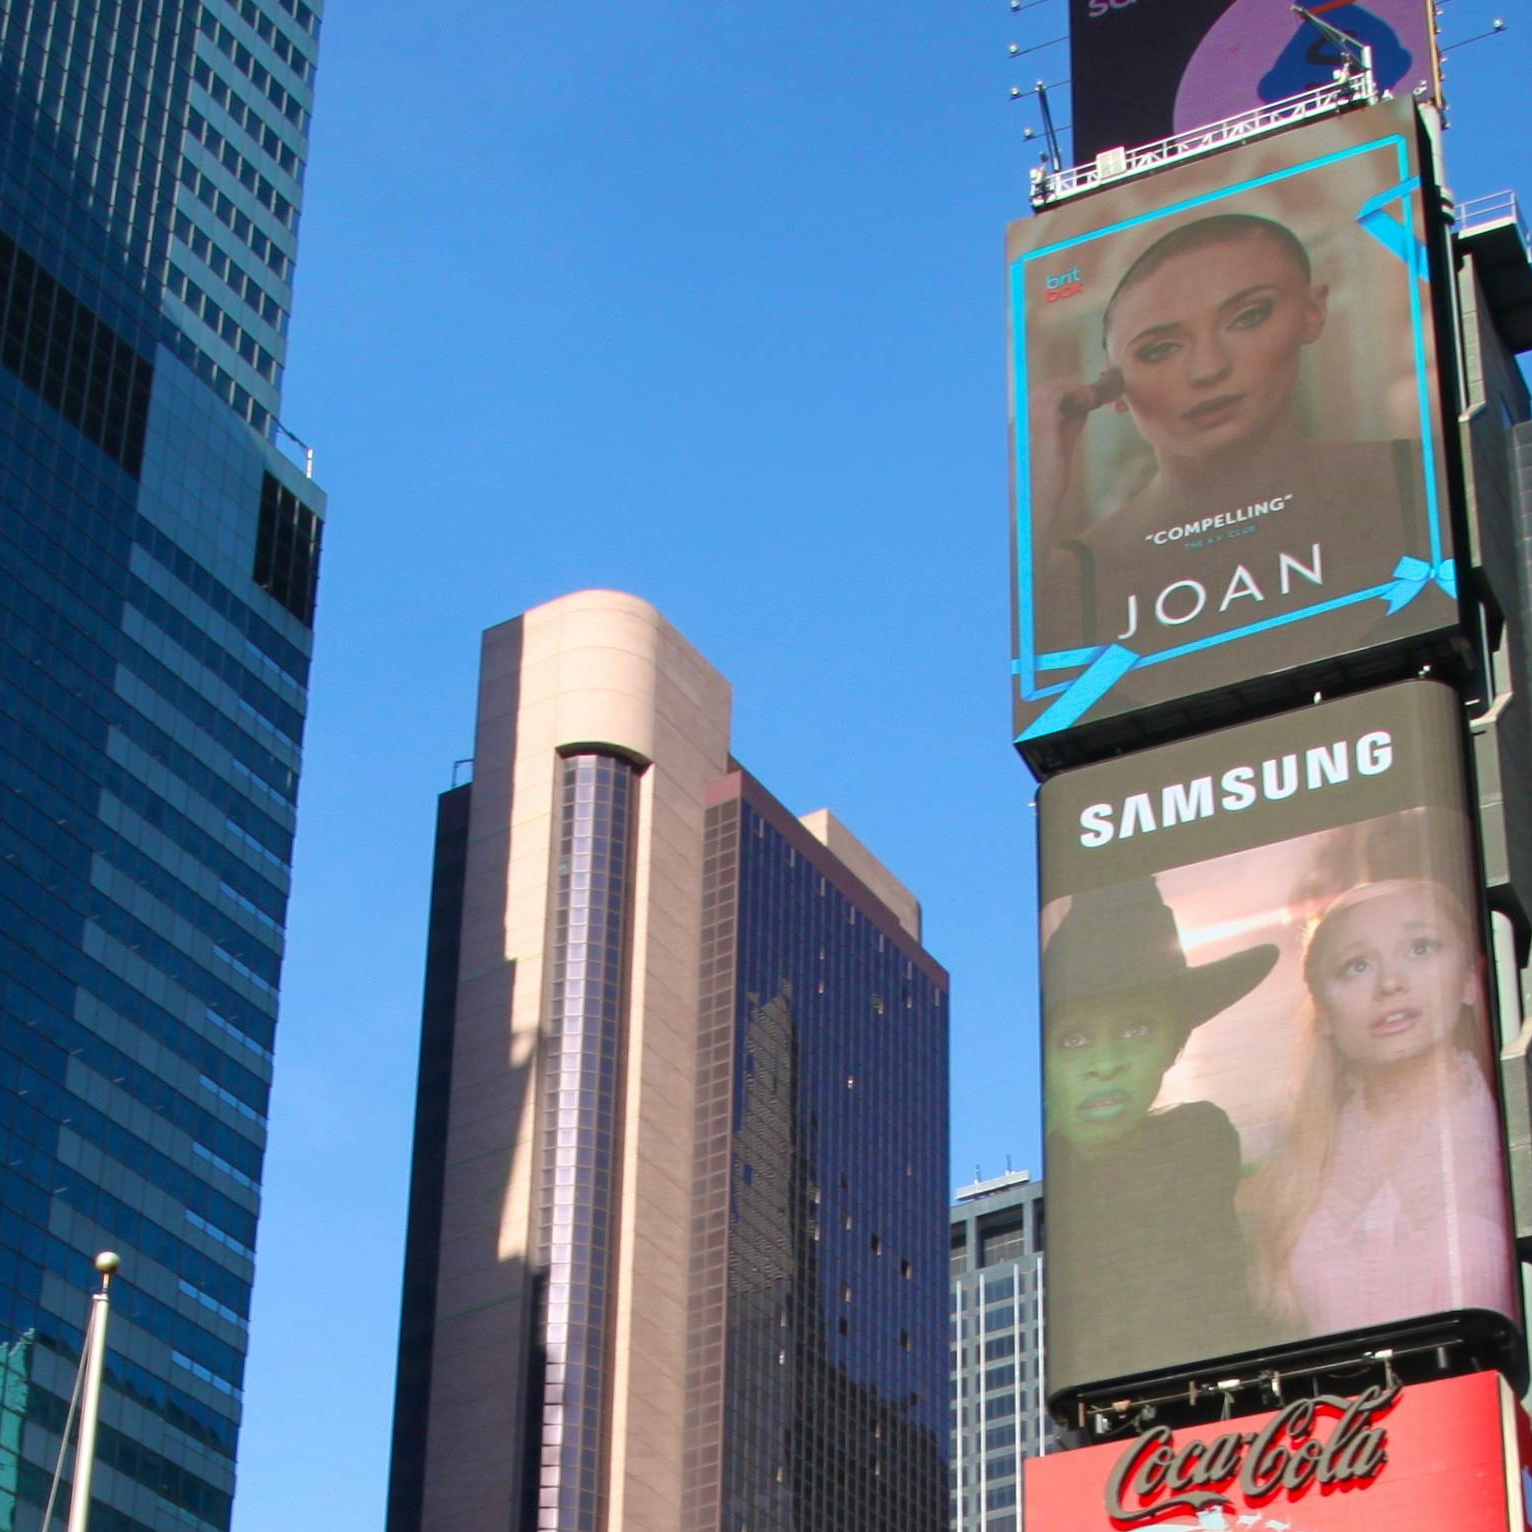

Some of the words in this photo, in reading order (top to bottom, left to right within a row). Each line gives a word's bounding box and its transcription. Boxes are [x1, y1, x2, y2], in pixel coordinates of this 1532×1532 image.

[1117, 542, 1323, 641] JOAN
[1079, 731, 1393, 848] SAMSUNG
[1104, 1380, 1404, 1521] Coca-Cola
